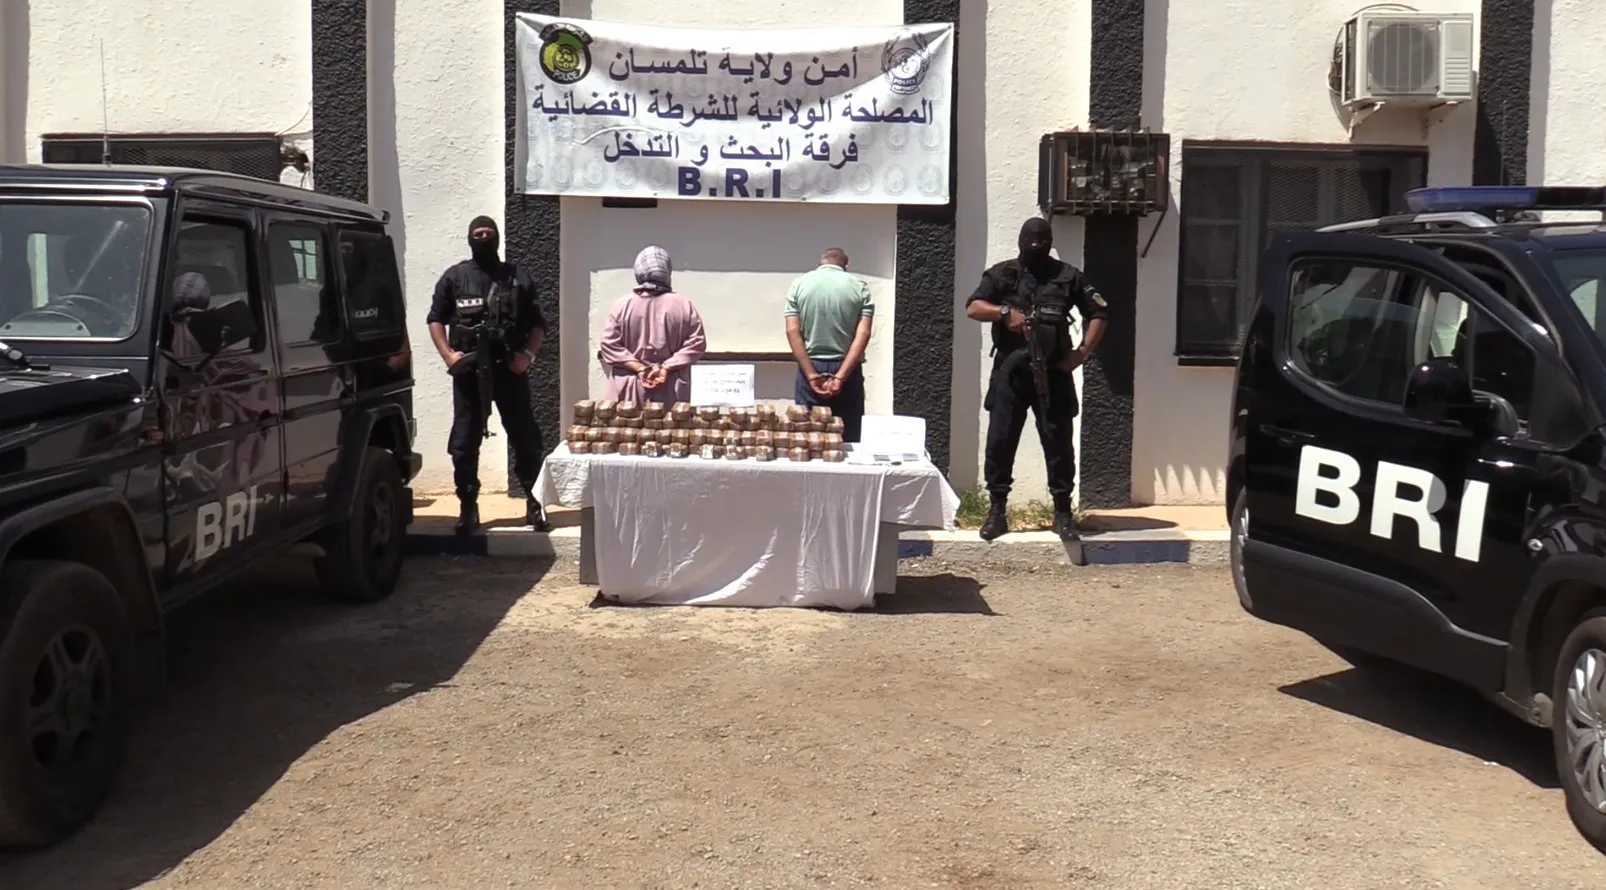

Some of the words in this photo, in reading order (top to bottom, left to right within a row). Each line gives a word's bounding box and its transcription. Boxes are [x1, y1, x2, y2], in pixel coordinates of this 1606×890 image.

[608, 47, 708, 81] تلمسان
[718, 46, 793, 86] ولاية
[803, 46, 858, 86] أمن
[893, 77, 916, 85] POLICE
[532, 84, 637, 122] القضائية
[647, 88, 738, 127] للشرطة
[747, 91, 833, 130] الولائية
[841, 93, 934, 125] المصلحة
[603, 131, 680, 163] التدخل
[690, 144, 709, 166] و
[719, 135, 790, 168] البحث
[802, 132, 859, 170] فرقة
[678, 166, 782, 198] B.R.I
[1295, 444, 1490, 562] BRI
[195, 484, 258, 562] BRI
